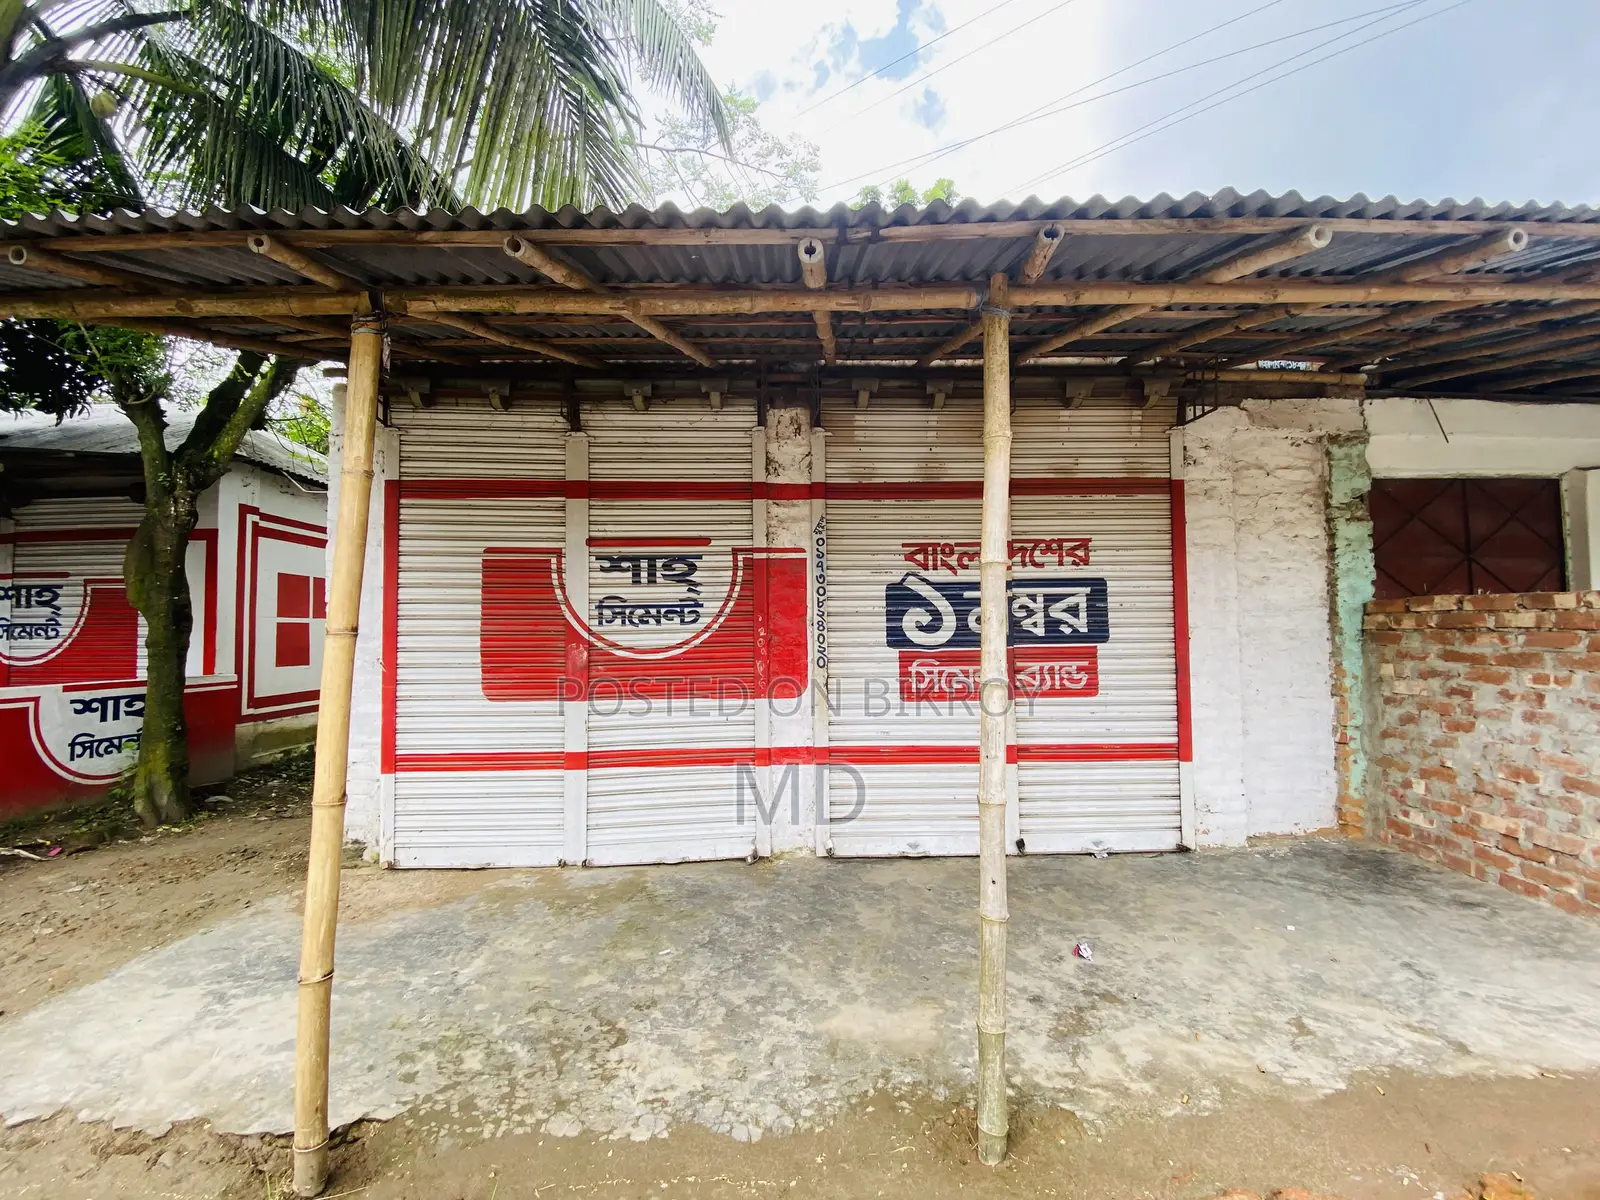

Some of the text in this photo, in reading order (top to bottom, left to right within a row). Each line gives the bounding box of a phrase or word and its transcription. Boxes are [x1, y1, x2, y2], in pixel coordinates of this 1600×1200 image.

[901, 538, 1092, 576] বাংলদশের
[595, 595, 704, 627] সিমেন্ট
[902, 577, 957, 646] ১
[908, 658, 981, 693] সিমে
[69, 693, 146, 723] শাহ
